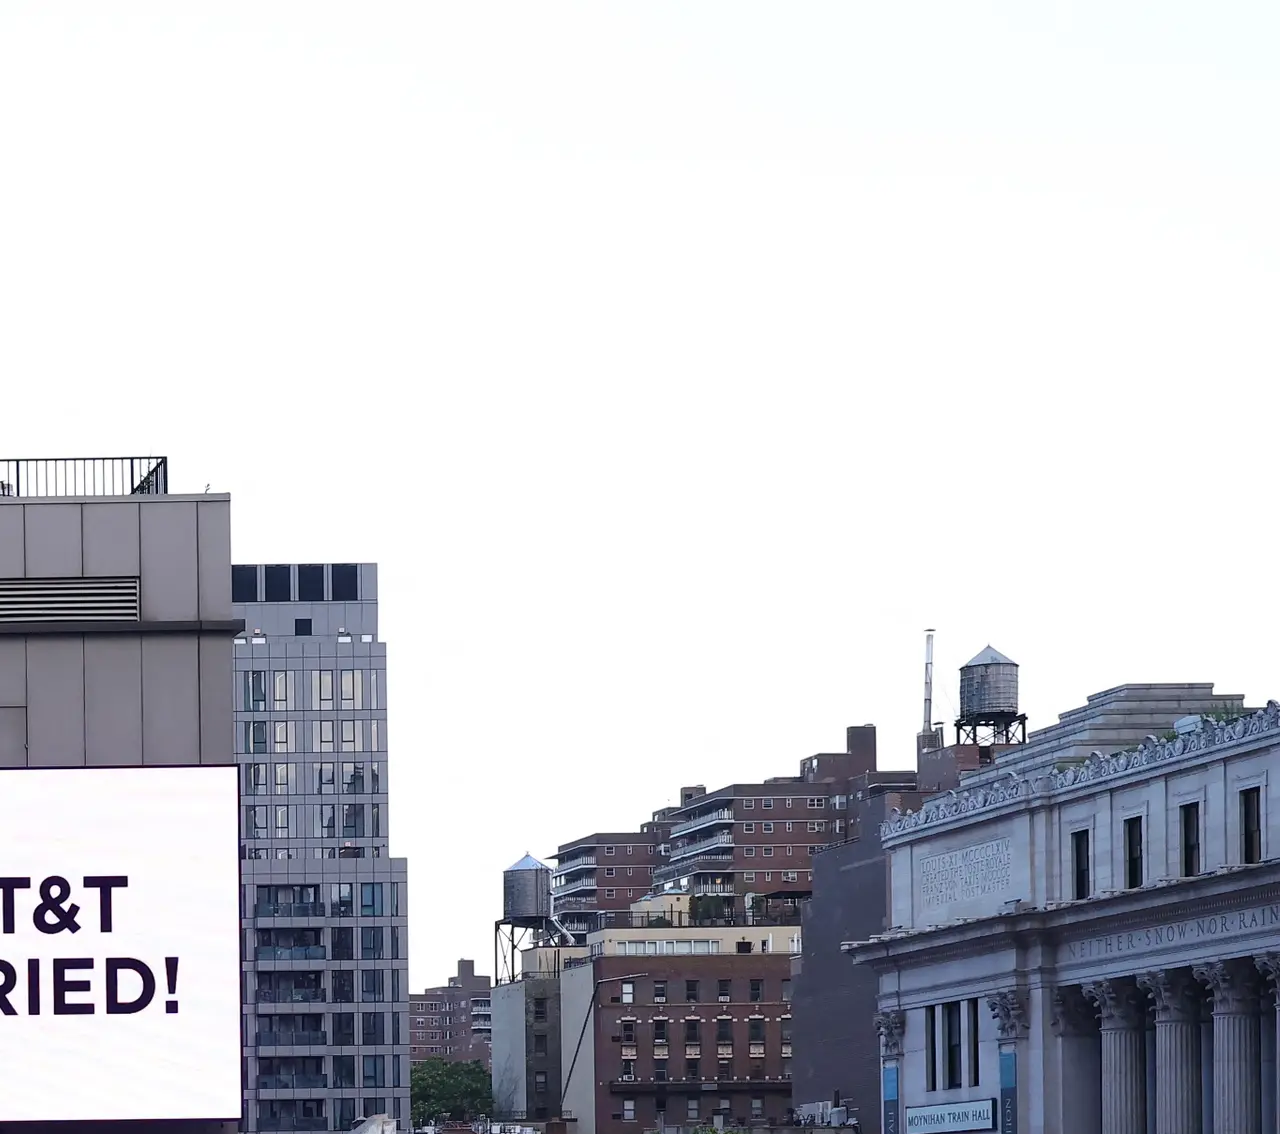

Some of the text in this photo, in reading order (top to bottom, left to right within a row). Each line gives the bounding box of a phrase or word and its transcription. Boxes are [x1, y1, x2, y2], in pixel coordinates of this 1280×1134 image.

[922, 857, 945, 874] LOUIS
[1068, 933, 1135, 961] NEITHER
[1145, 923, 1188, 946] SNOW
[1196, 915, 1230, 937] NOR
[908, 1109, 990, 1127] MOYNIHAN TRAIN HALL
